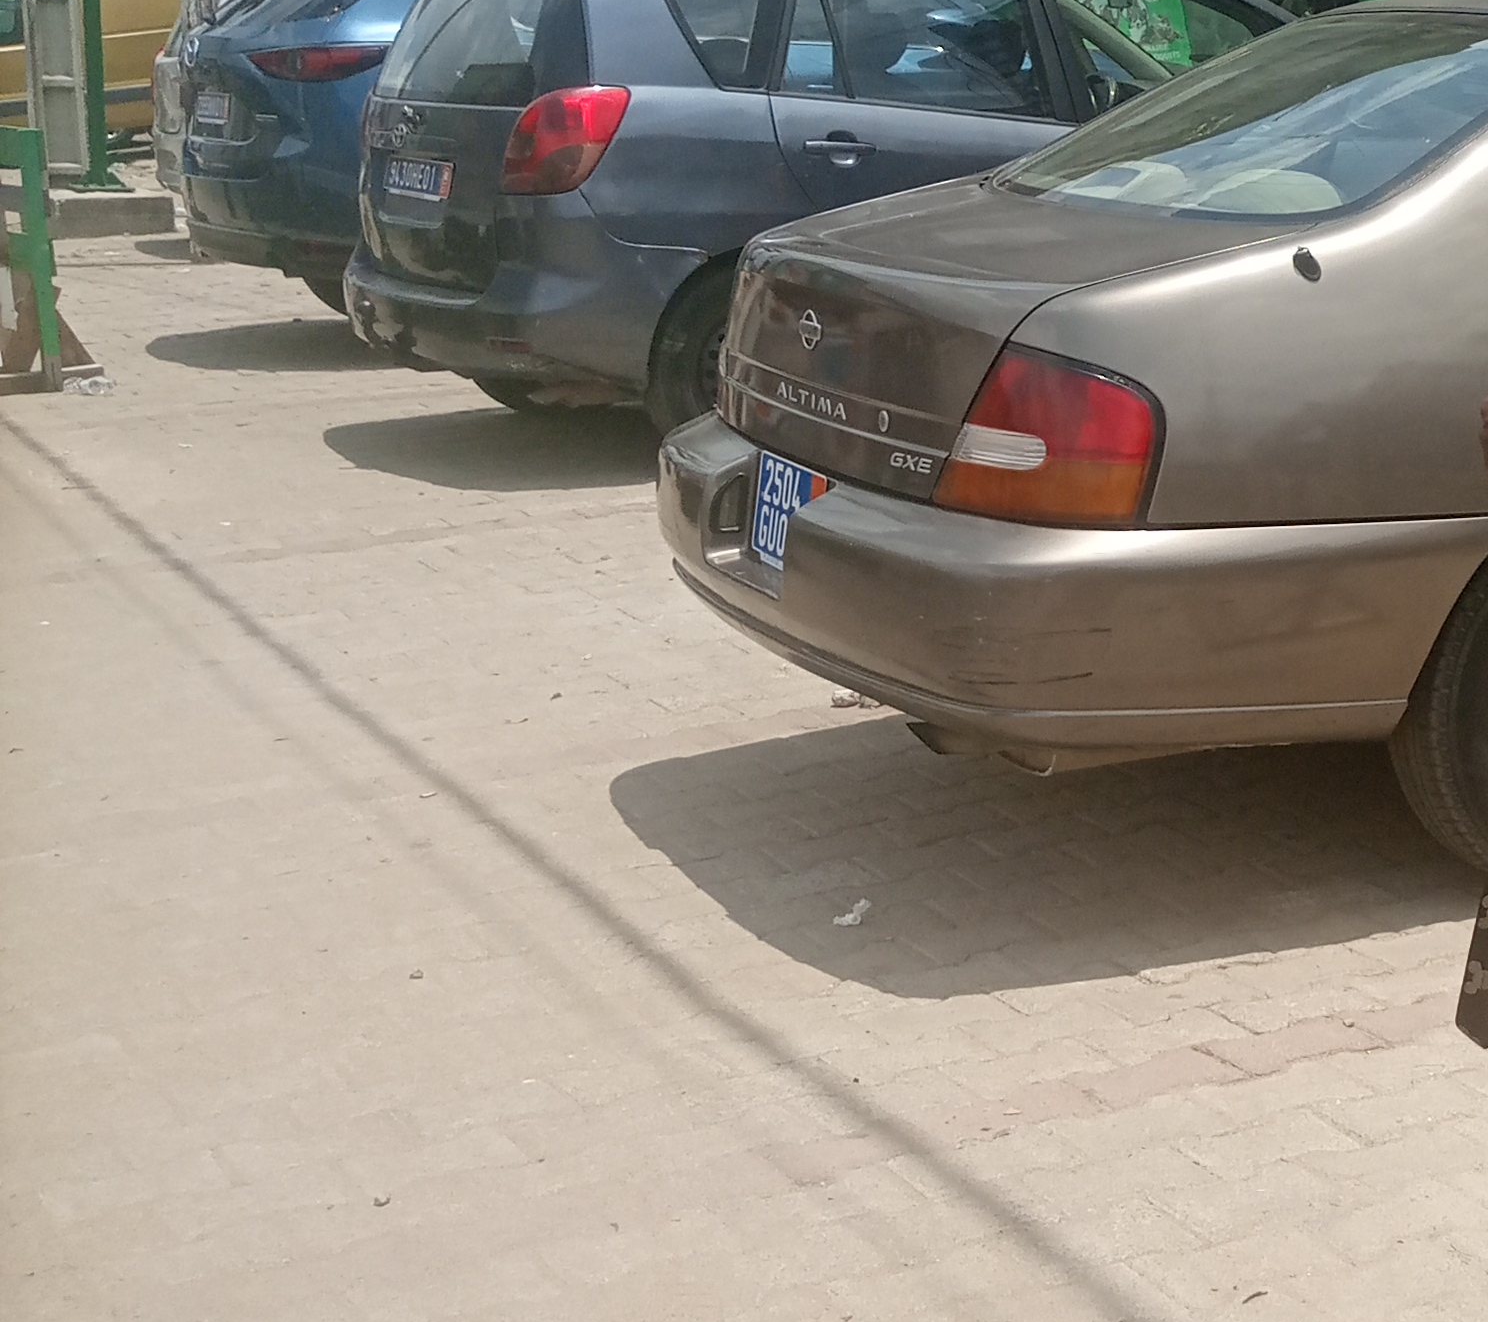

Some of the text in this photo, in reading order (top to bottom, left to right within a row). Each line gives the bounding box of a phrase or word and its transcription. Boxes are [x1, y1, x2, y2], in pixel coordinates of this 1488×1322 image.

[776, 380, 848, 421] ALTIMA
[889, 451, 933, 474] GXE
[762, 458, 802, 511] 2504
